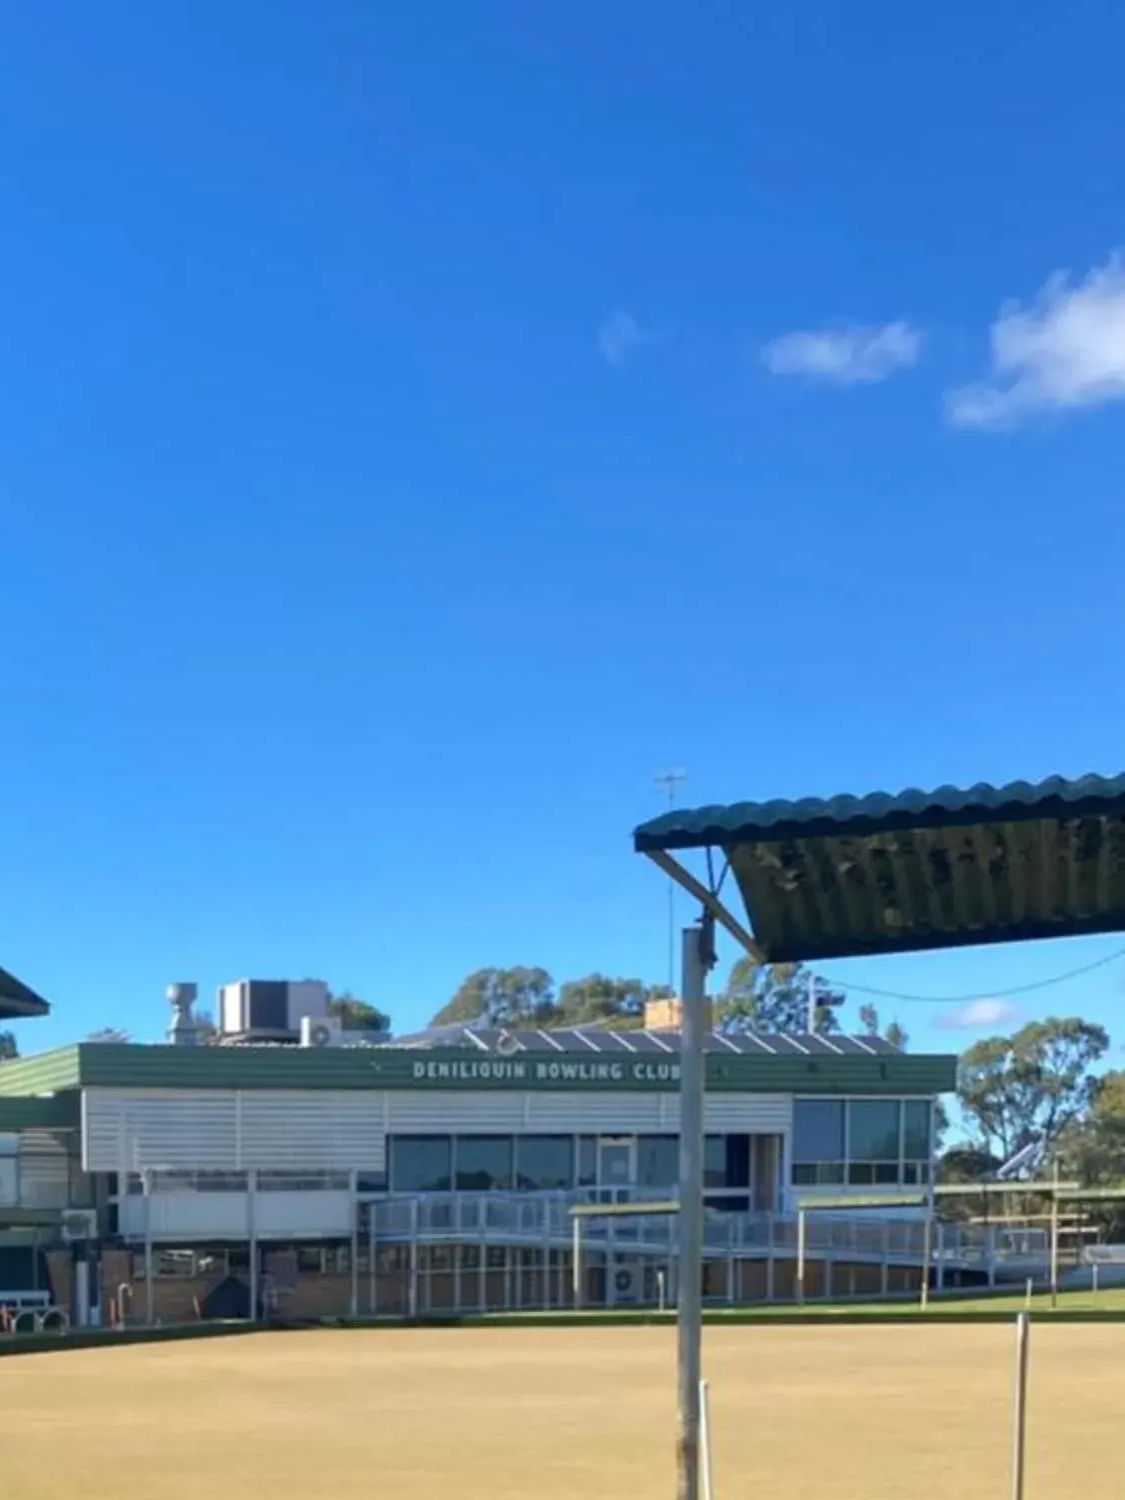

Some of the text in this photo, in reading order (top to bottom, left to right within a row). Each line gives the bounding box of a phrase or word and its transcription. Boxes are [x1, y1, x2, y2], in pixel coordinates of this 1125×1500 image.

[413, 1061, 681, 1080] DENILIQUIN BOWLING CLUB
